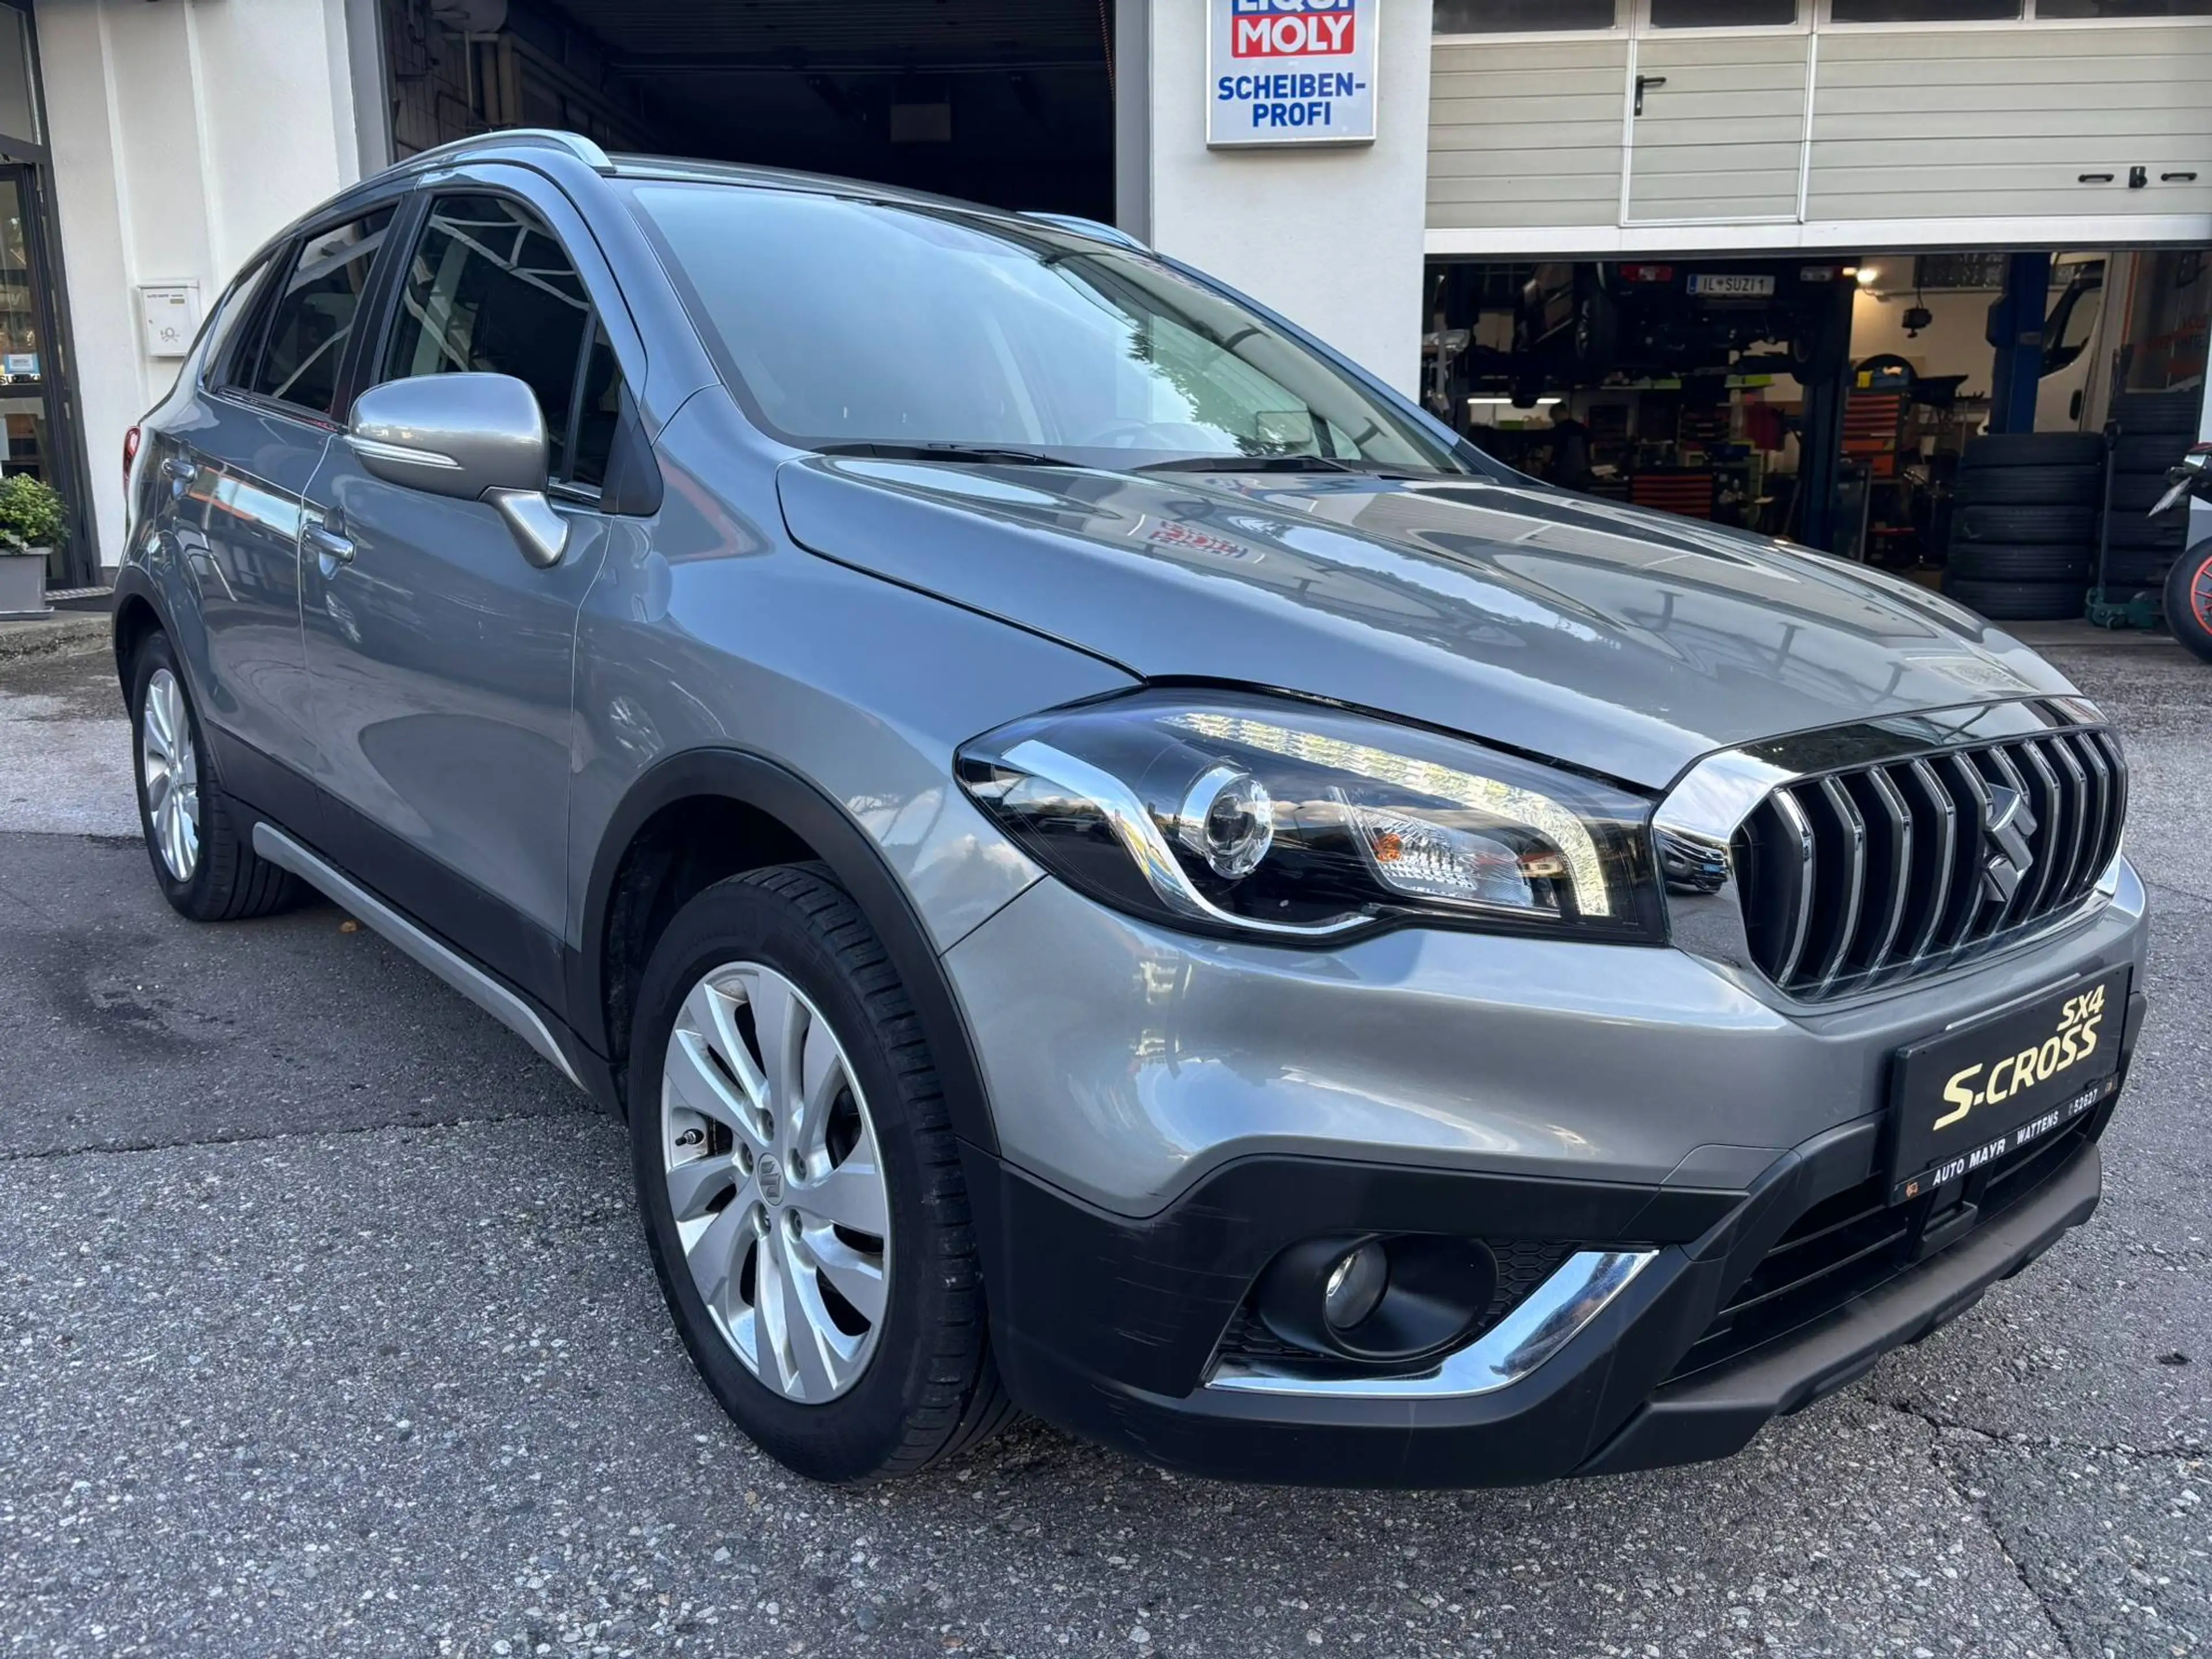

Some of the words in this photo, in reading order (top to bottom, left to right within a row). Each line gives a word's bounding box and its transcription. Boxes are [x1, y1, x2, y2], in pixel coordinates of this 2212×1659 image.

[1237, 15, 1353, 54] MOLY
[1218, 73, 1366, 100] SCHEIBEN-
[1253, 101, 1331, 127] PROFI
[2056, 984, 2105, 1032] SX4
[1932, 1158, 1964, 1187] AUTO
[1969, 1138, 2006, 1169] MAYR
[2017, 1110, 2059, 1145] WATTENS
